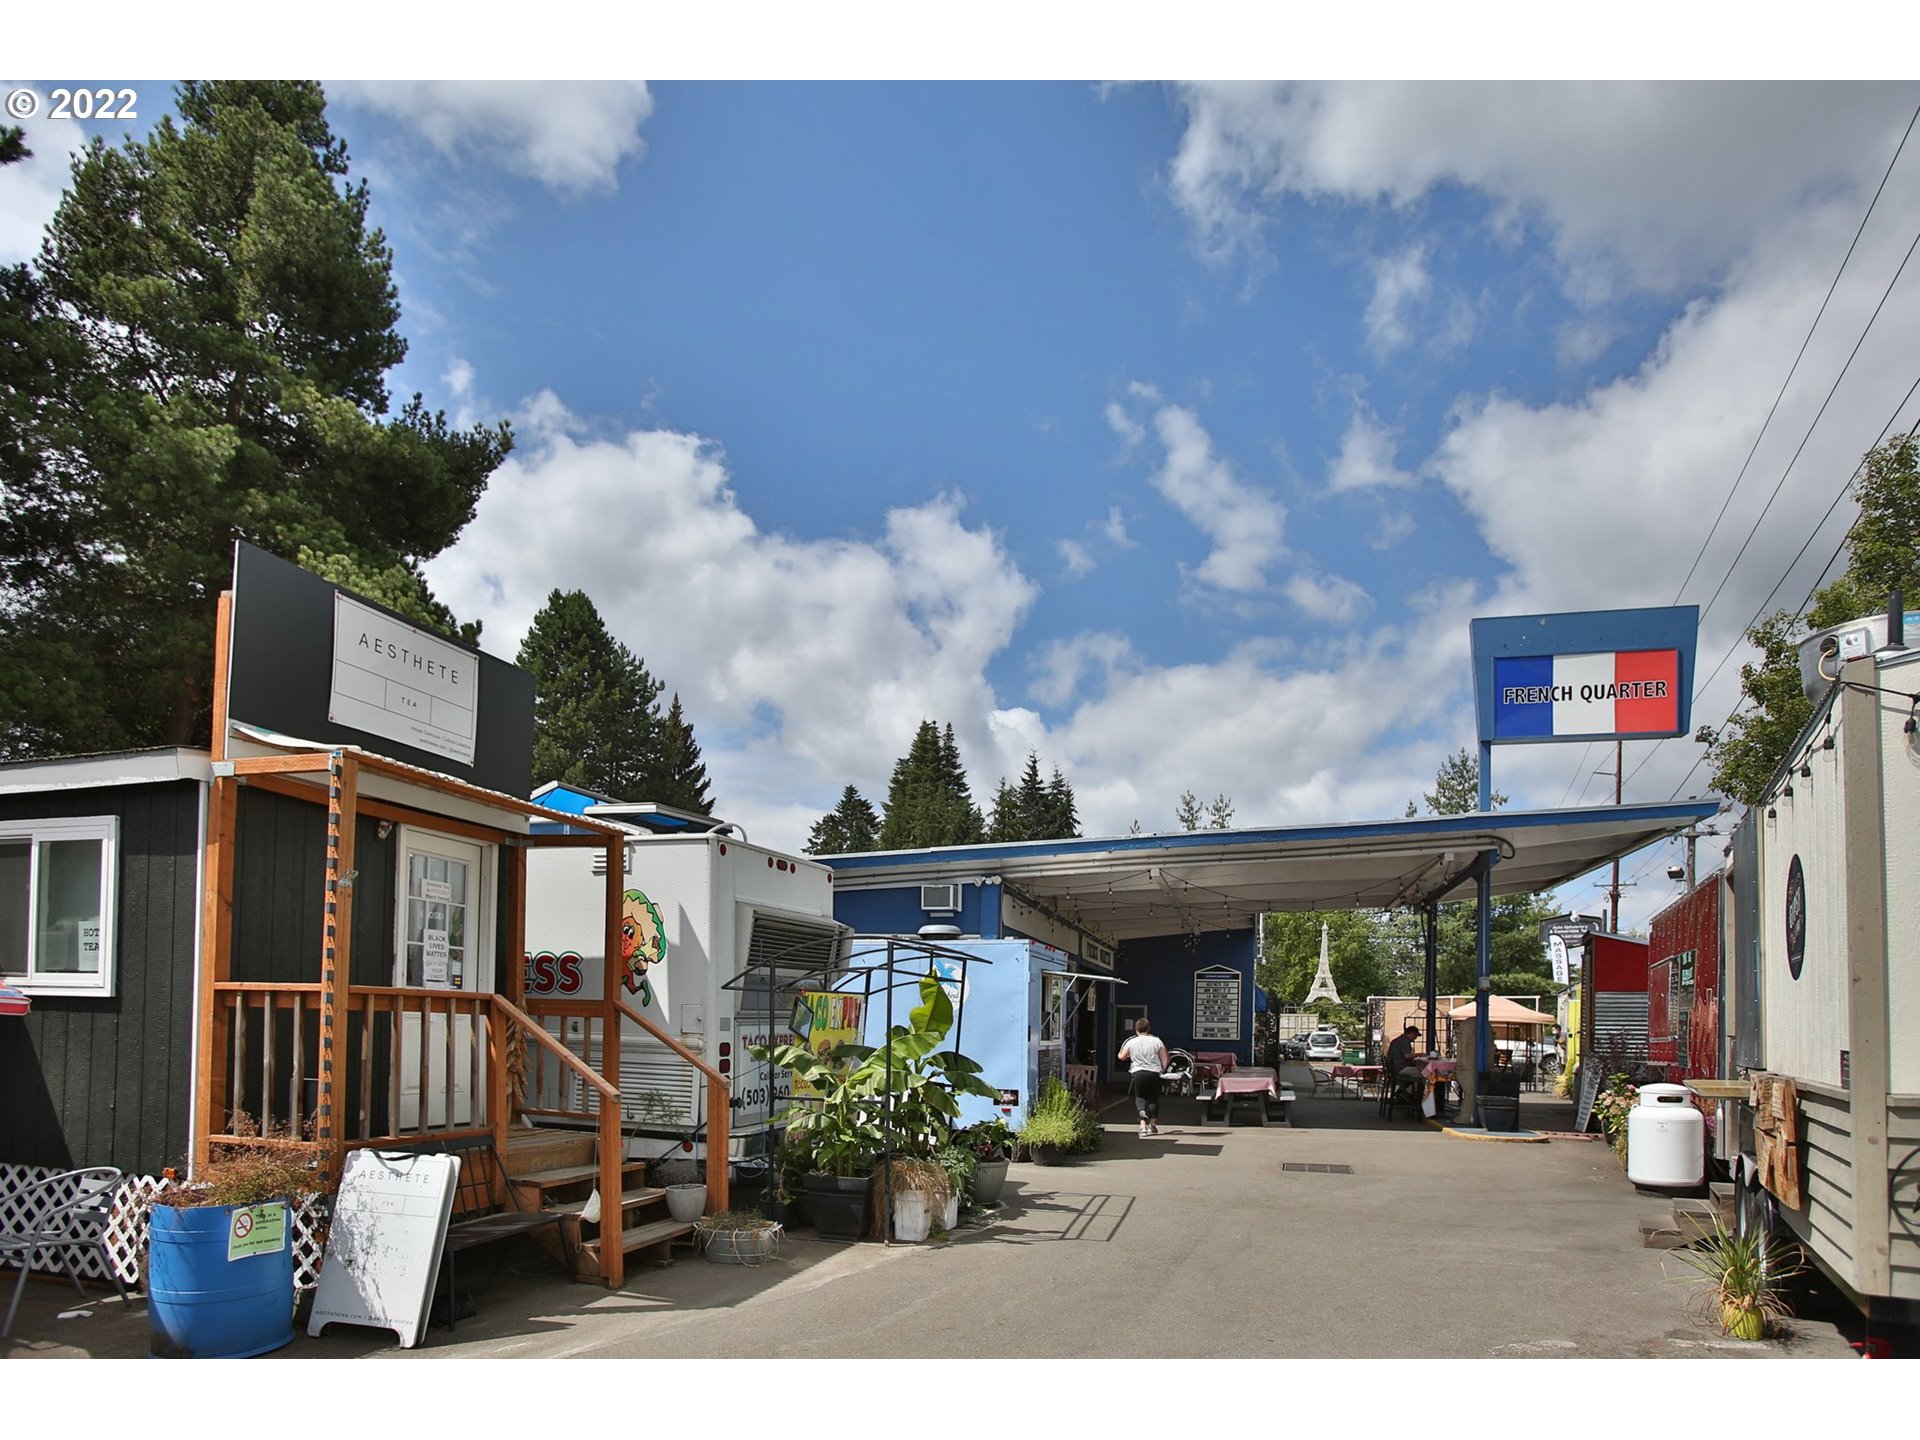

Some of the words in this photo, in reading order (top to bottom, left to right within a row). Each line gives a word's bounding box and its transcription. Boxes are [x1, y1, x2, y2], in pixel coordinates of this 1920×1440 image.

[358, 632, 459, 684] AESTHETE
[1503, 686, 1573, 704] FRENCH
[1580, 680, 1668, 703] QUARTER
[400, 696, 418, 709] TEA
[428, 934, 446, 942] BLACK
[426, 950, 447, 958] MATTER
[1554, 941, 1563, 982] MASSAGE
[741, 1086, 770, 1110] (503)
[359, 1169, 430, 1184] AESTHETE
